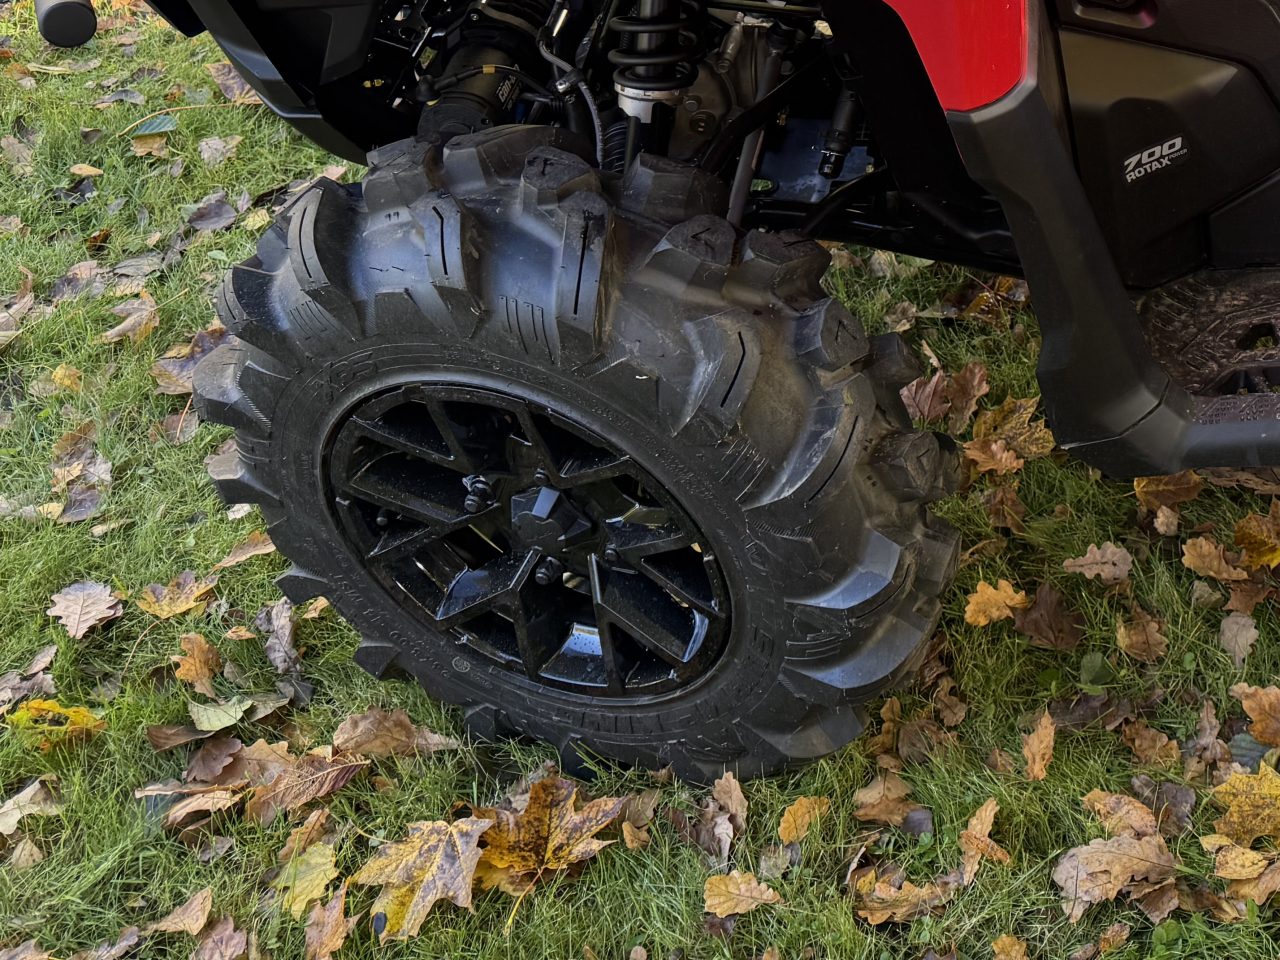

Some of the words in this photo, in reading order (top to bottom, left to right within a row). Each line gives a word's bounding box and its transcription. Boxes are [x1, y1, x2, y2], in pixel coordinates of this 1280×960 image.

[1124, 136, 1183, 174] 700
[1125, 156, 1172, 183] ROTAX
[1168, 148, 1188, 159] POWER
